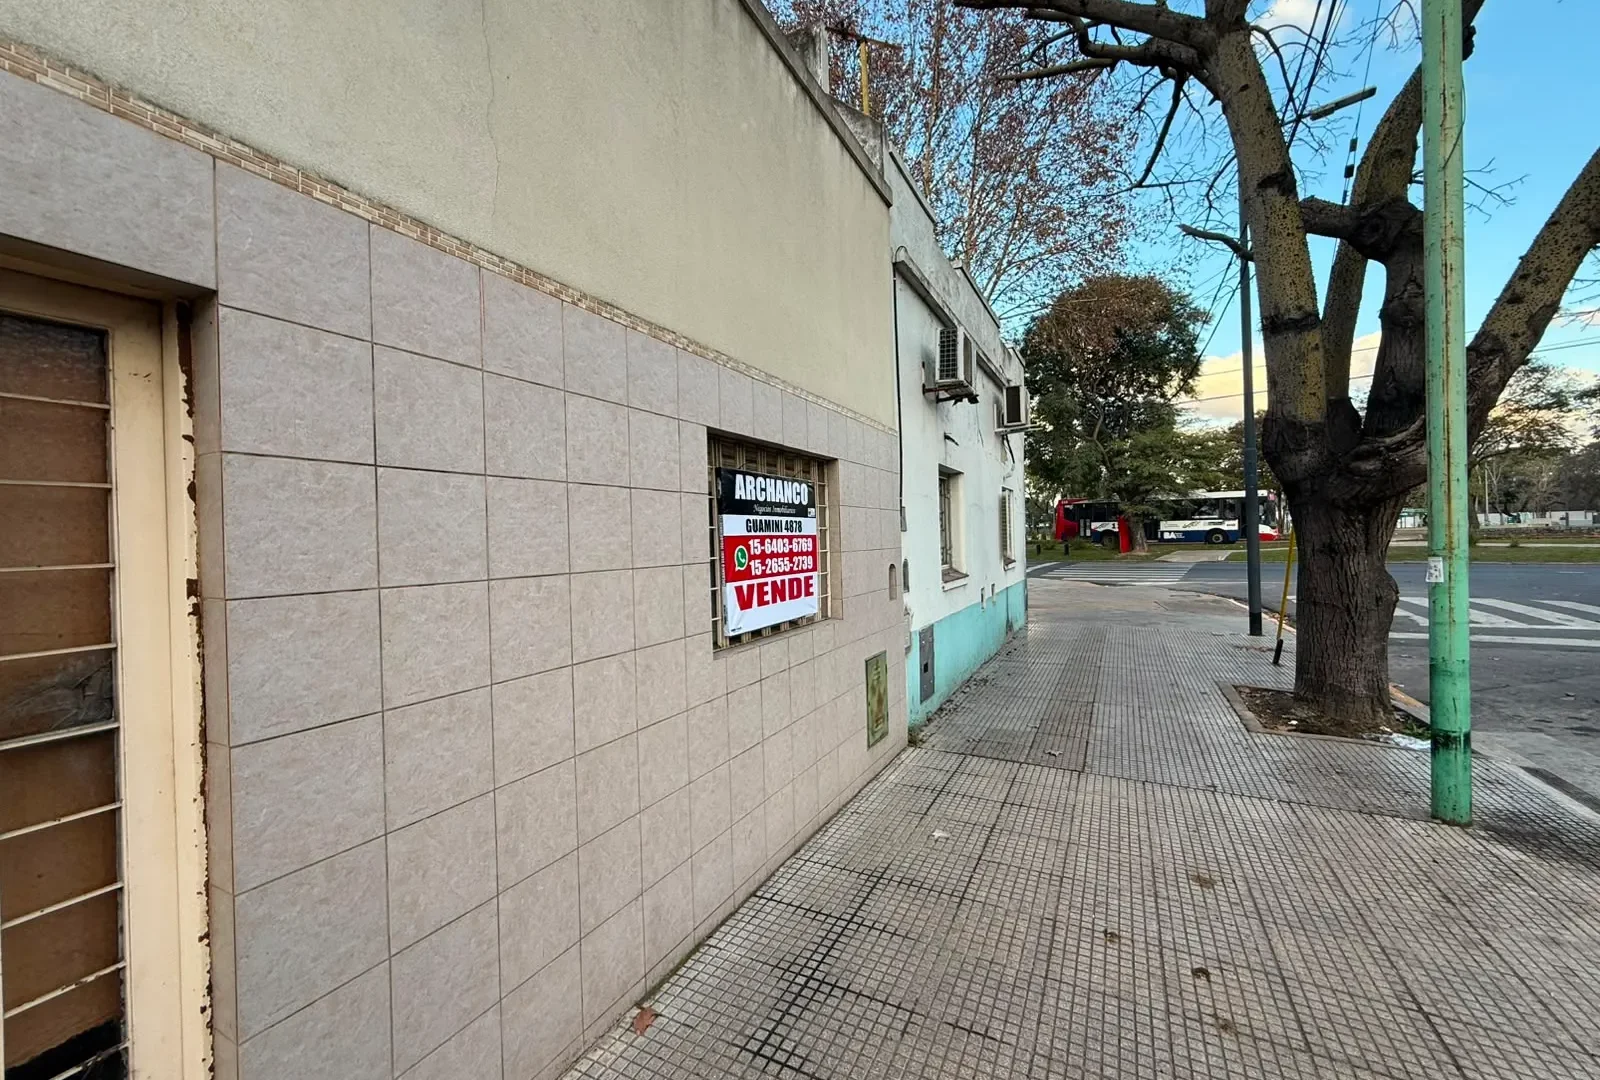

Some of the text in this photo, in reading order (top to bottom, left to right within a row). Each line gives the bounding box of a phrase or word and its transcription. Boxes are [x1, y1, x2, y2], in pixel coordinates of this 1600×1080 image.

[735, 474, 808, 505] ARCHANCO
[746, 519, 802, 533] GUAMINI 4878
[748, 537, 813, 555] 15-6403-6769
[749, 555, 813, 576] 15-2655-2739
[735, 576, 814, 611] VENDE
